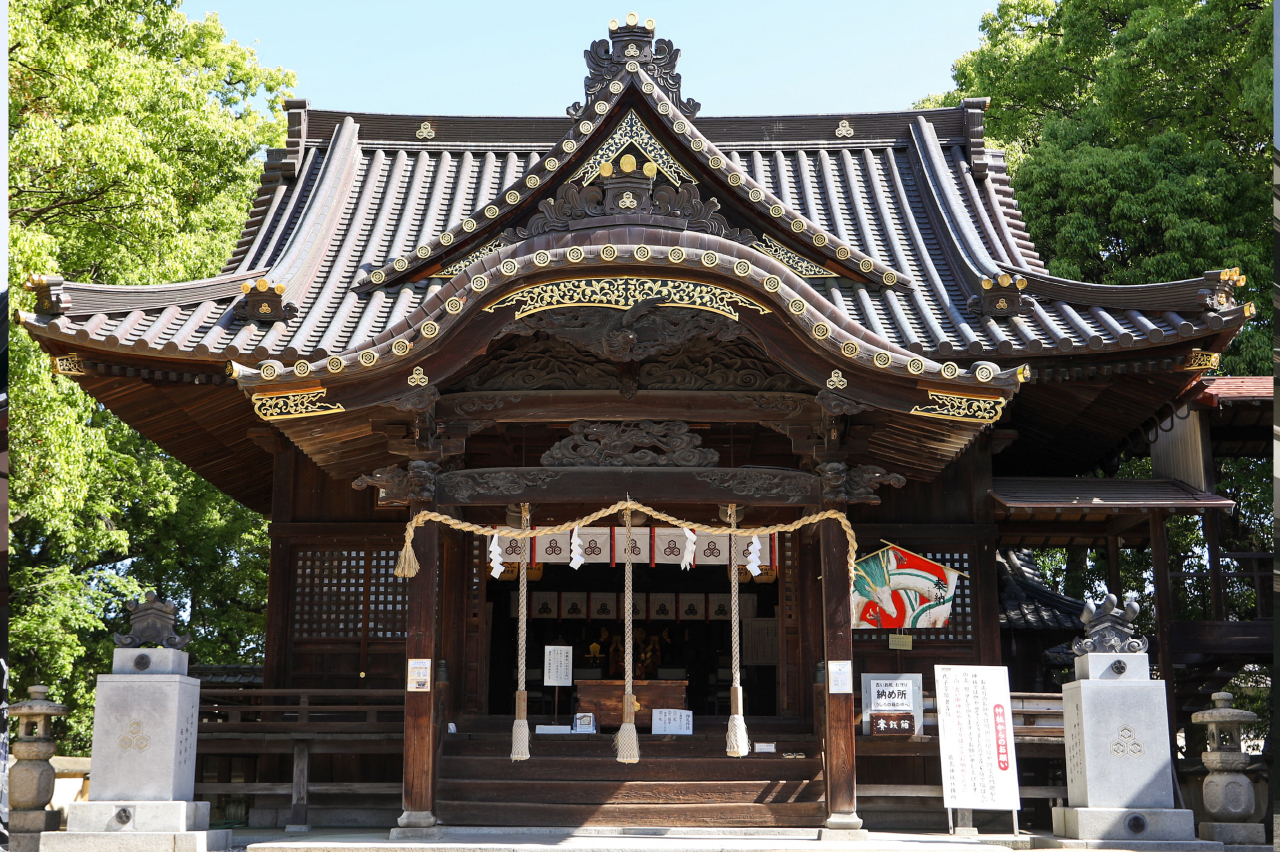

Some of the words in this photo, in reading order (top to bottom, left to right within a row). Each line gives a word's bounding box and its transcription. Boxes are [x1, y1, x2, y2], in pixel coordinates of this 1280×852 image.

[933, 577, 947, 605] 奉納
[876, 689, 907, 699] 納め所
[994, 706, 1008, 768] 神社からのお願い
